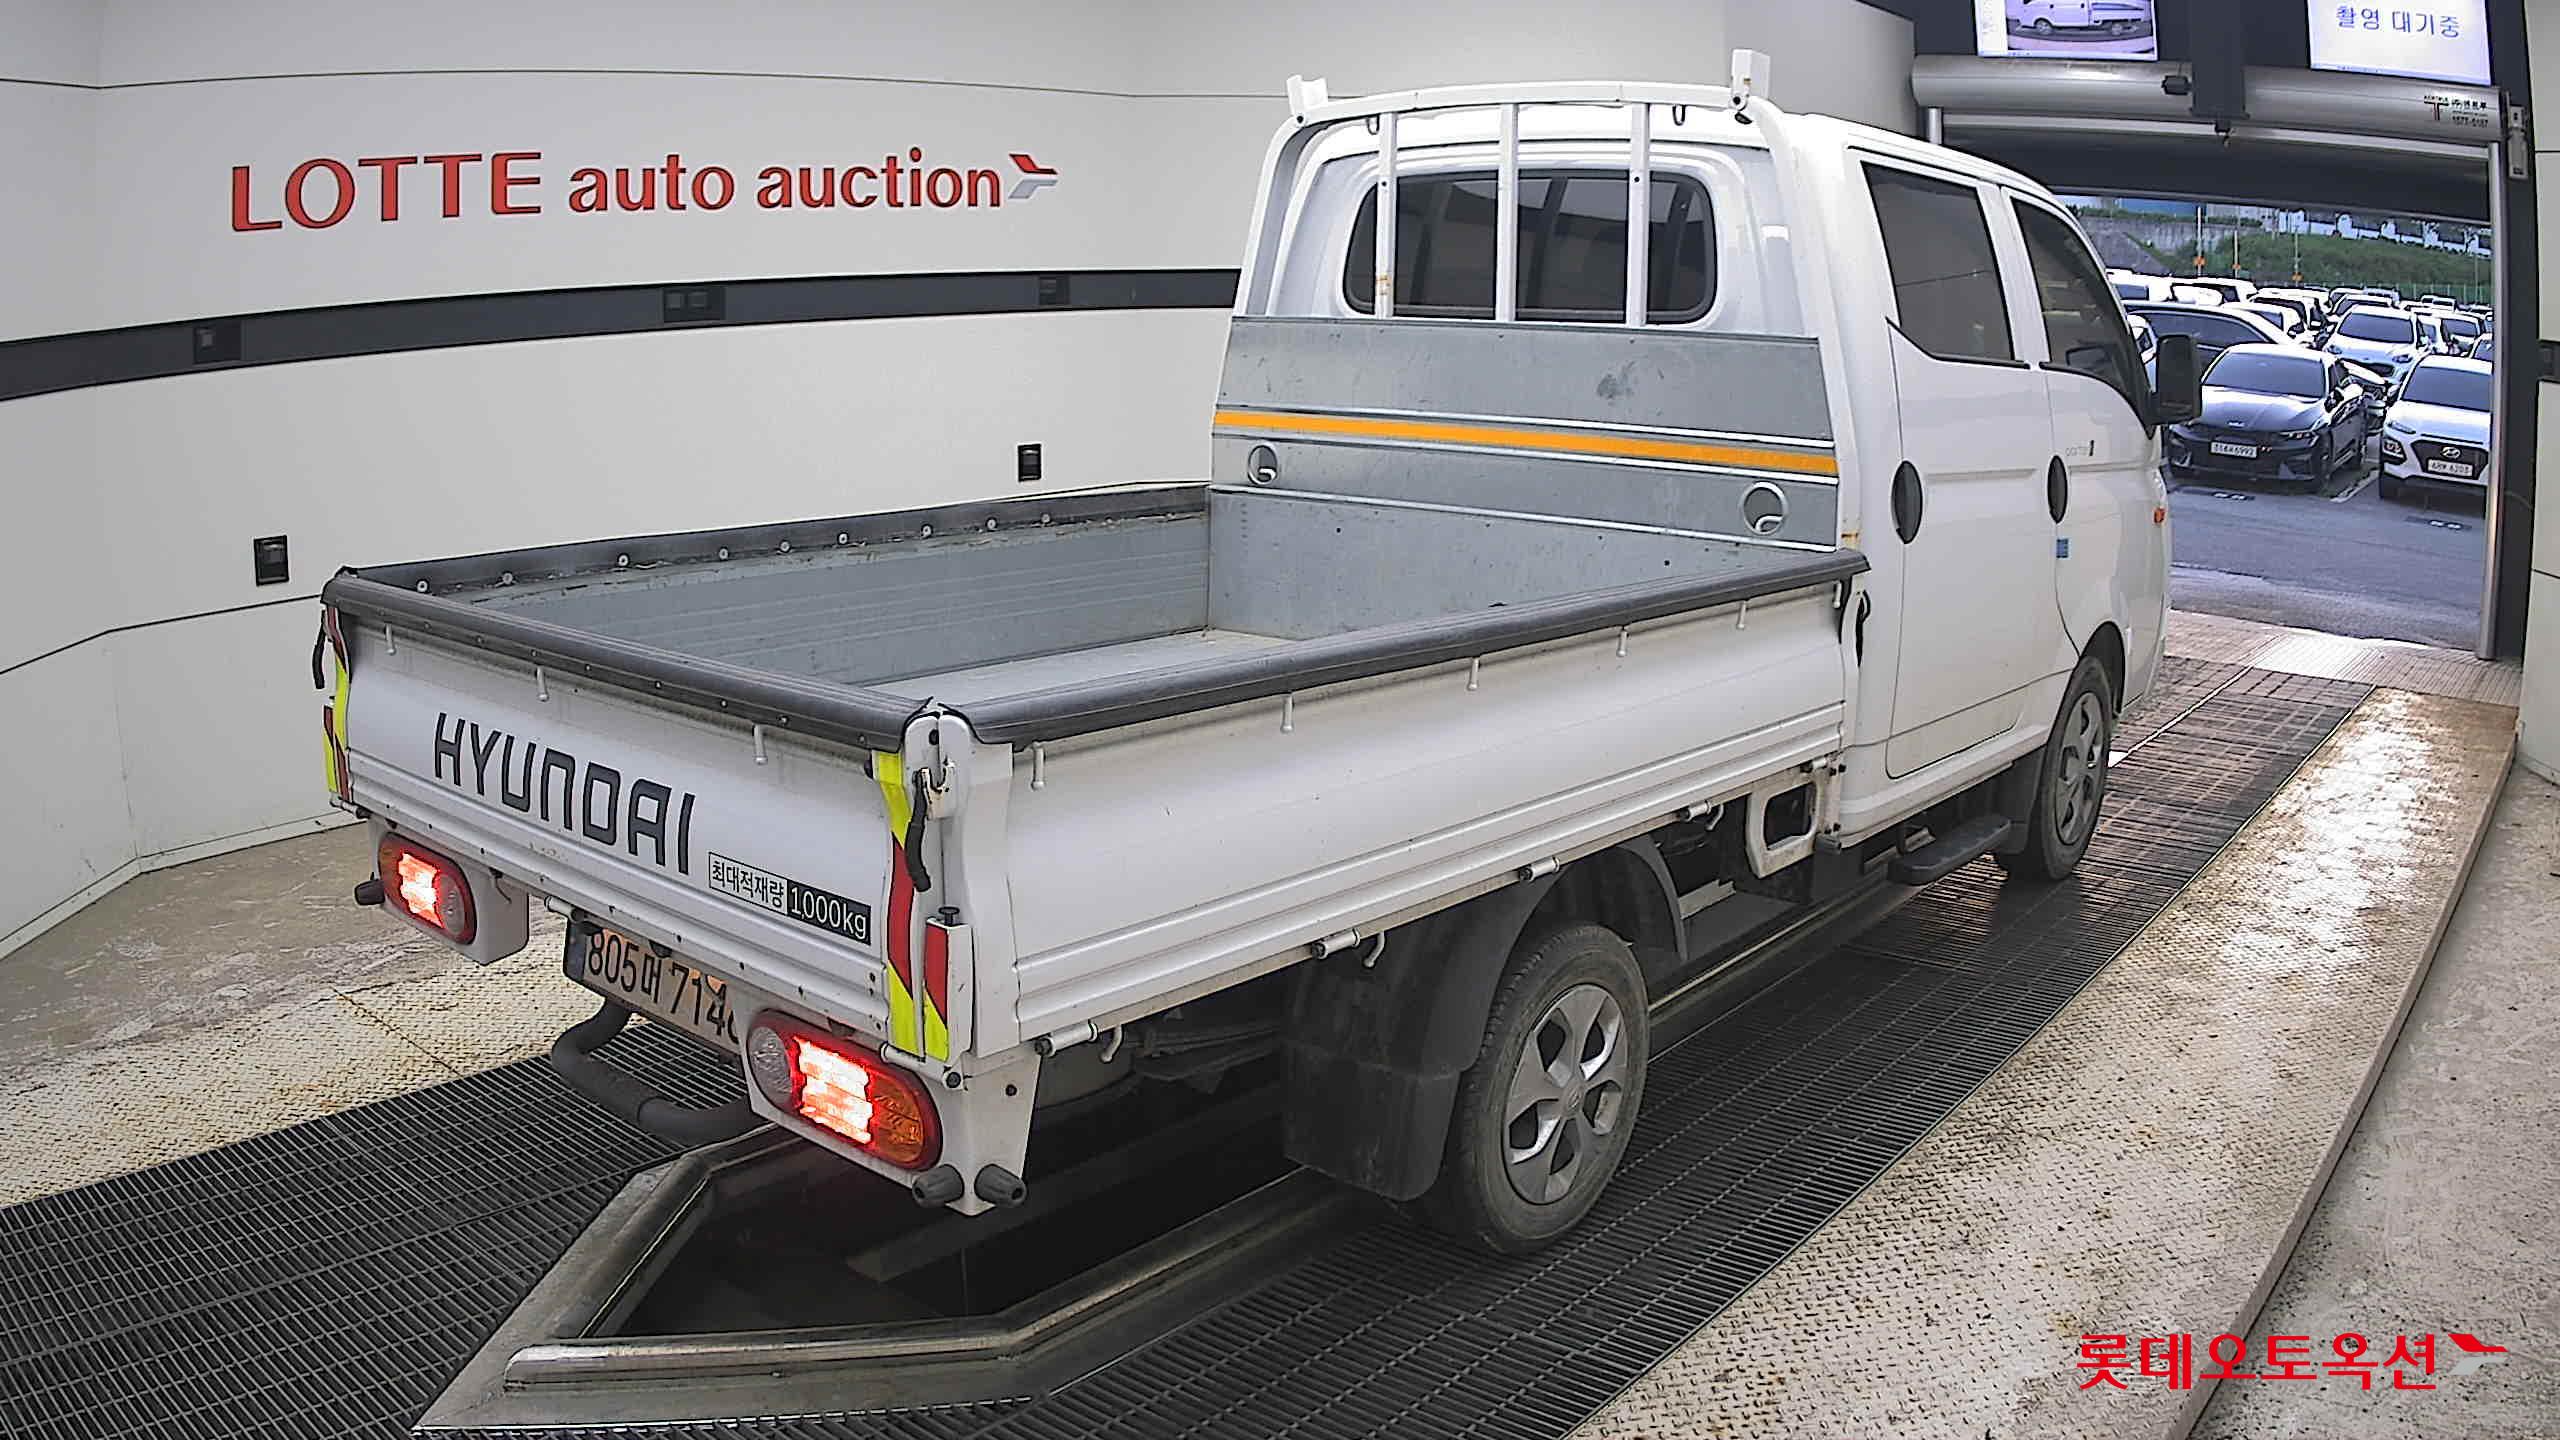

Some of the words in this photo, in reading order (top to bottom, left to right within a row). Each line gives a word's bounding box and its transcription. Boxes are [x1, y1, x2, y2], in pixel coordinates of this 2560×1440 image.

[2392, 11, 2460, 38] 대기중
[232, 151, 542, 232] LOTTE
[568, 153, 735, 212] auto
[757, 146, 1002, 209] auction
[434, 712, 696, 876] HYUNDAI
[712, 860, 785, 909] 최대적재량
[790, 886, 867, 940] 1,000kg
